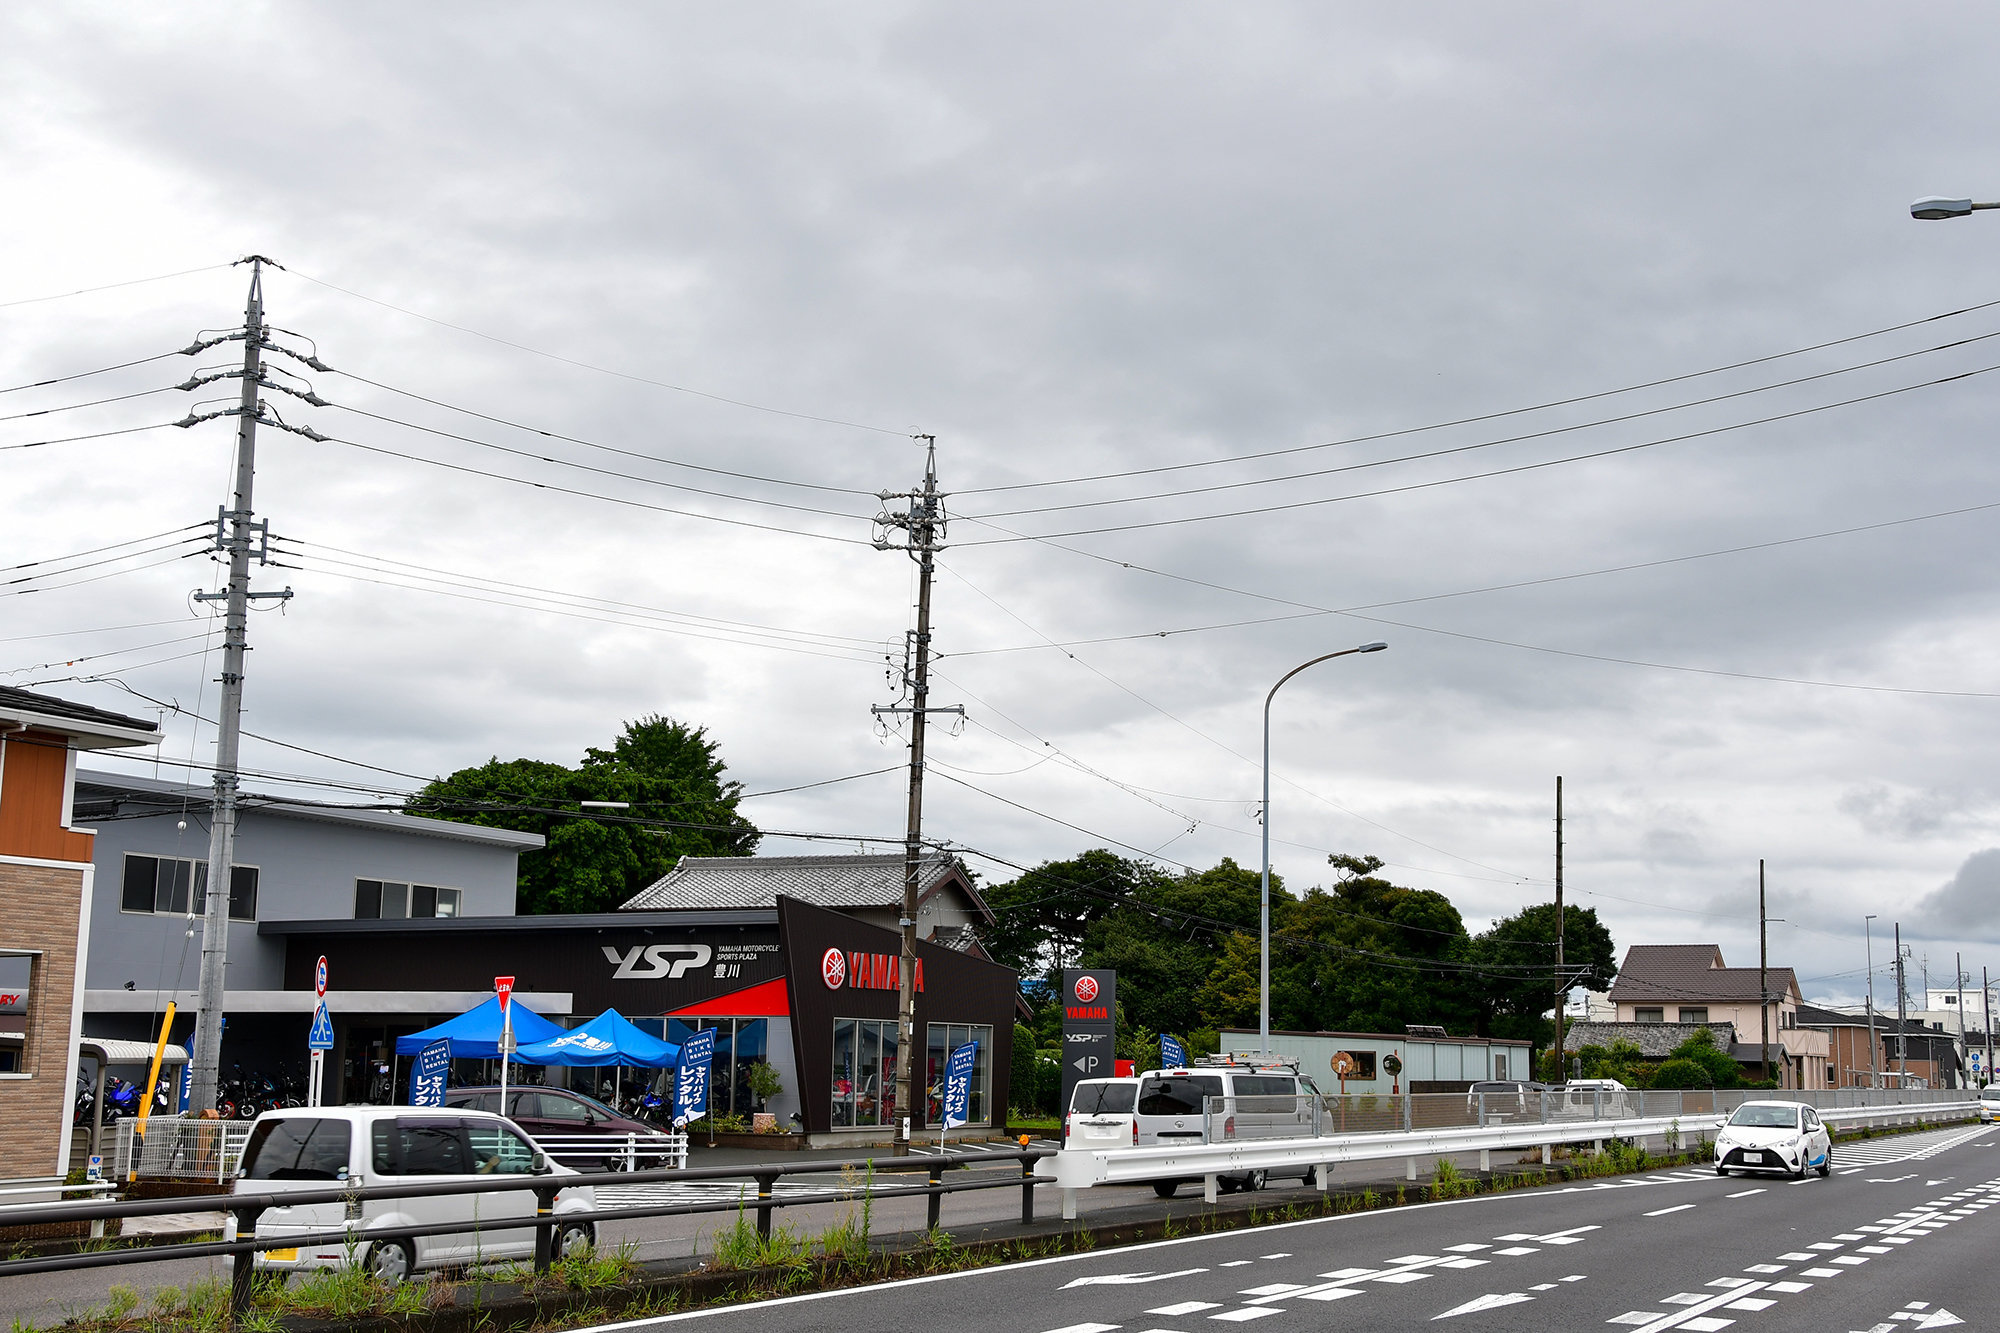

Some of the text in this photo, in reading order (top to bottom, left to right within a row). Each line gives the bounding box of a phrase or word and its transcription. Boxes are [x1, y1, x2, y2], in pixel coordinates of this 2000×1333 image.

[742, 944, 780, 952] MOTORCYCLE
[601, 944, 712, 979] YSP
[713, 963, 741, 978] 豊川
[847, 951, 925, 993] YAMAA
[1066, 1006, 1108, 1019] YAMAHA
[687, 1037, 710, 1047] YAMAHA
[1066, 1033, 1092, 1042] YSP
[423, 1046, 446, 1056] YAMAHA
[689, 1050, 712, 1060] RENTAL
[425, 1059, 449, 1069] RENTAL
[1088, 1056, 1099, 1073] P
[678, 1065, 695, 1105] レンタル
[693, 1066, 707, 1105] ヤマハバイク
[945, 1075, 958, 1112] レンタル
